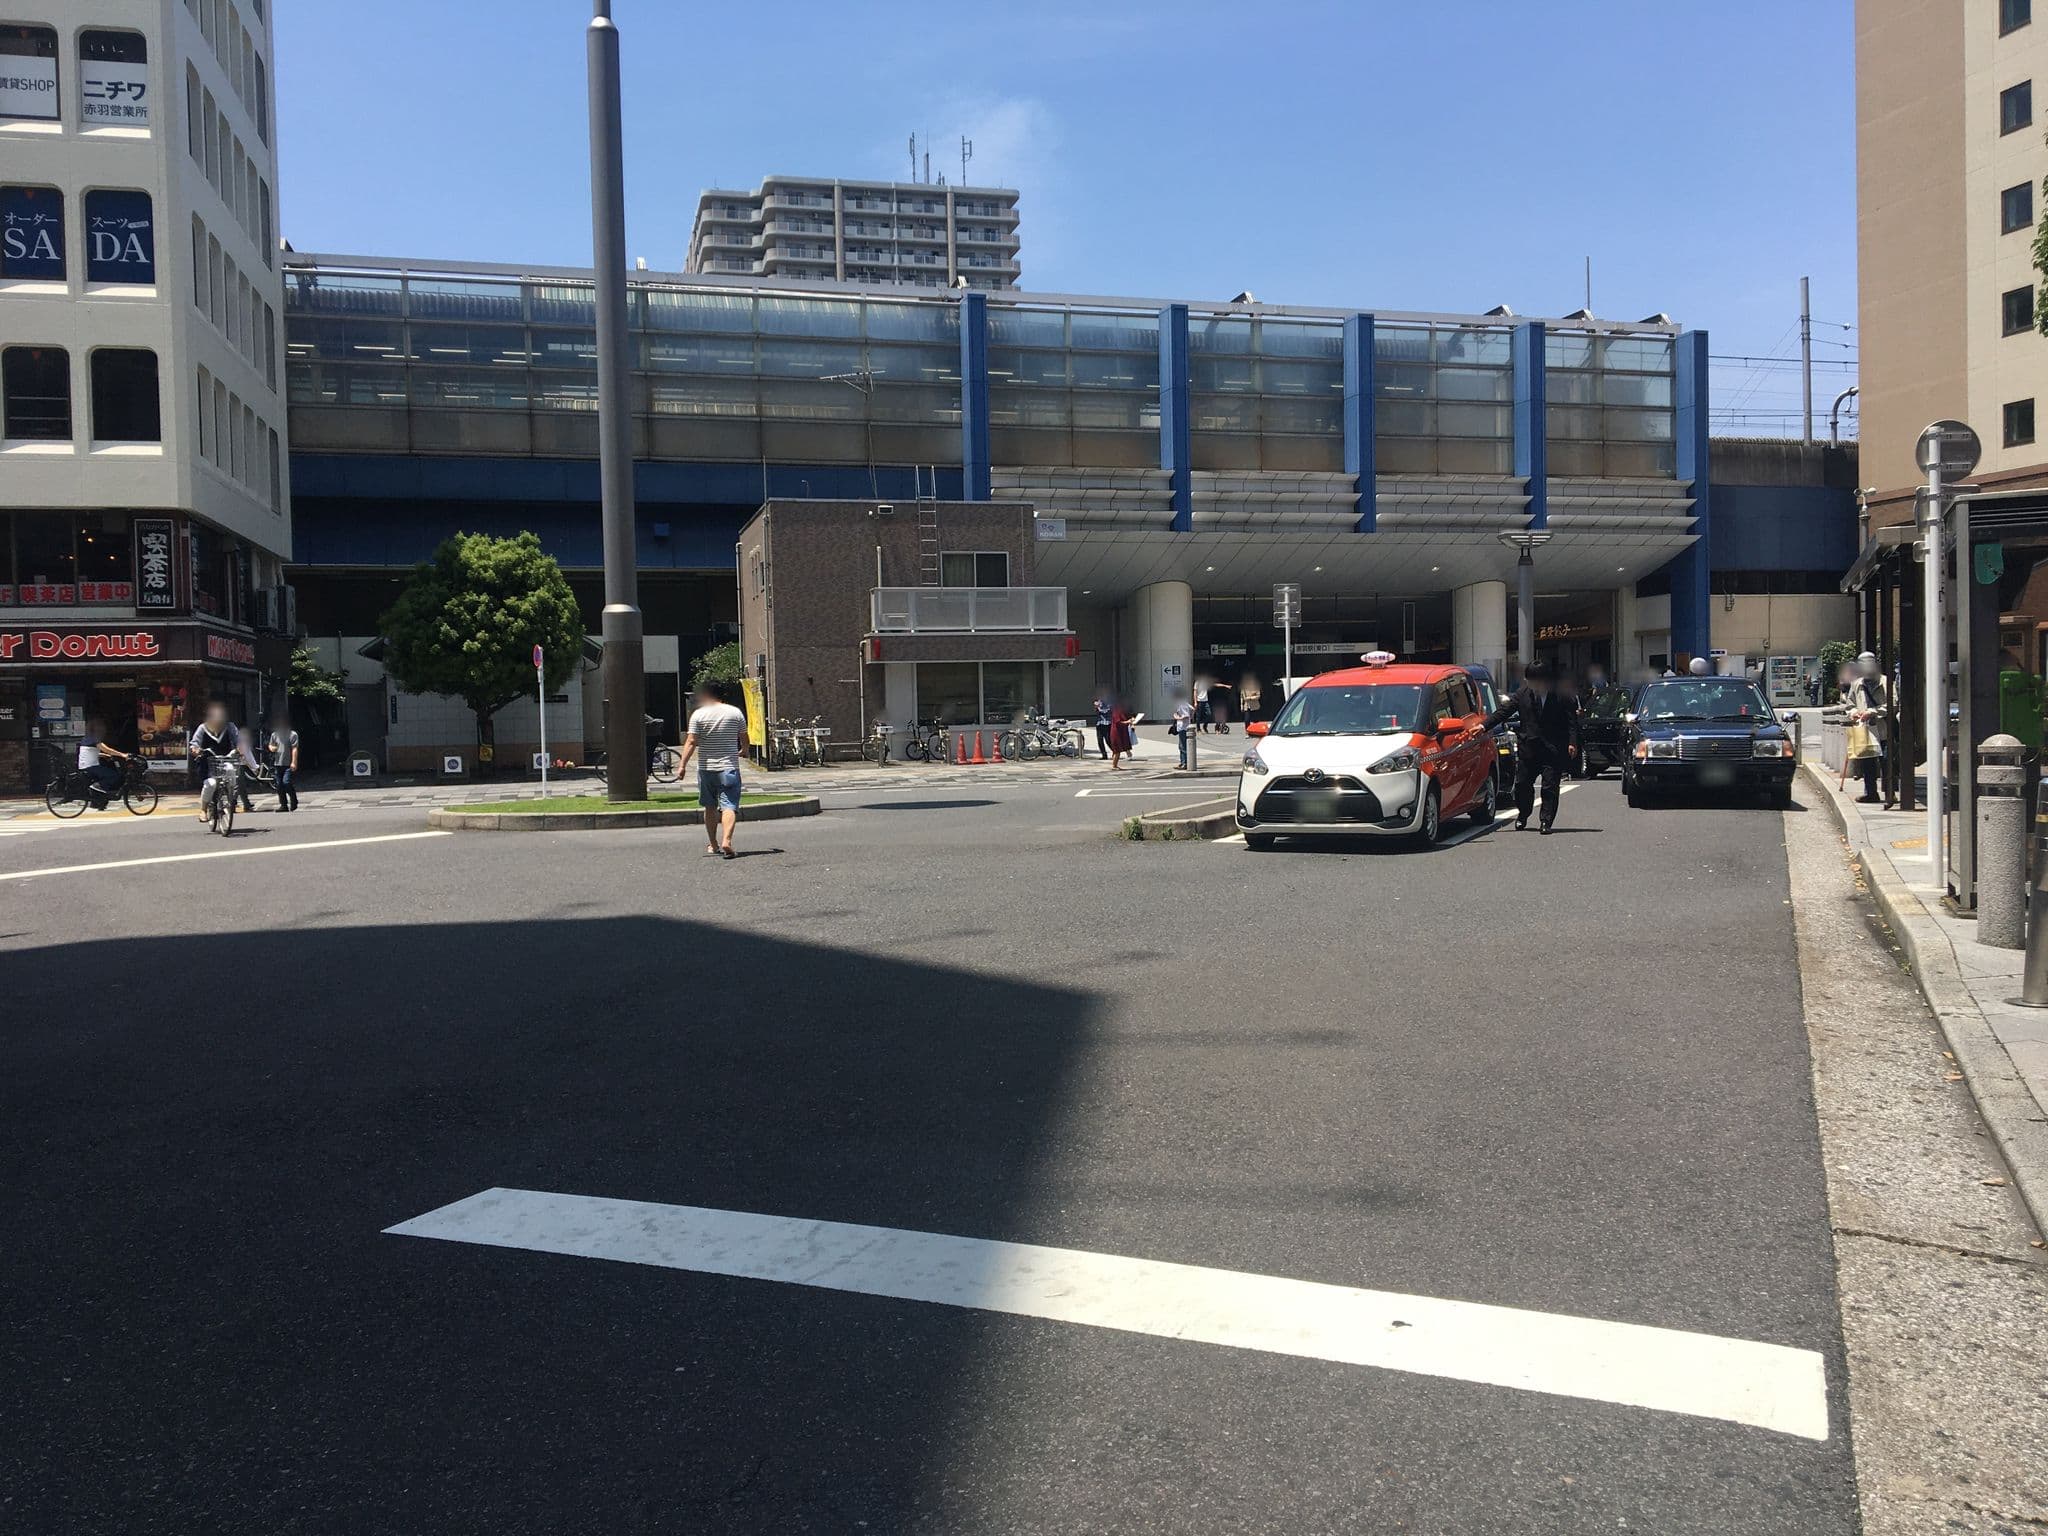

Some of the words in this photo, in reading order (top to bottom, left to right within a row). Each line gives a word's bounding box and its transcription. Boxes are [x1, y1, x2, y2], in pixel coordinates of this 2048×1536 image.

[84, 80, 146, 101] ニチワ
[84, 104, 148, 118] 赤羽営業所
[4, 212, 58, 225] オーダー
[91, 216, 128, 228] スーツ
[81, 583, 131, 601] 営業中
[29, 631, 159, 658] Donut
